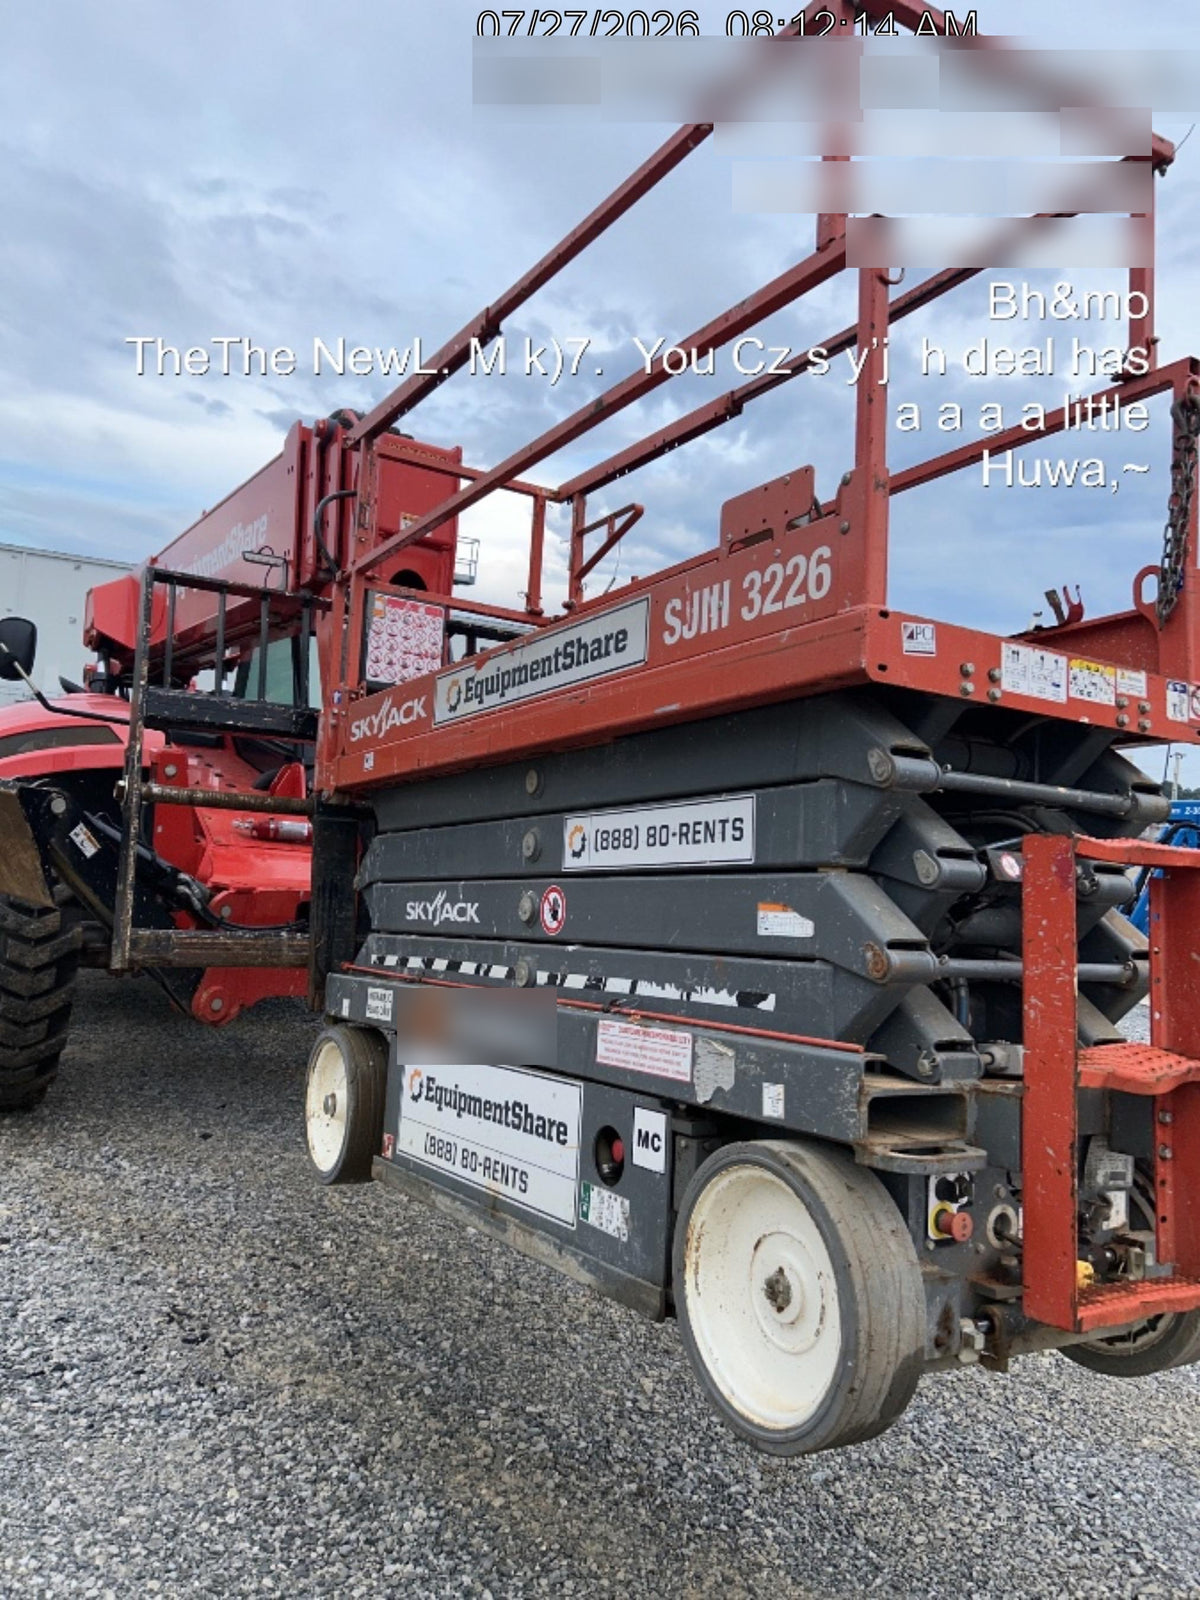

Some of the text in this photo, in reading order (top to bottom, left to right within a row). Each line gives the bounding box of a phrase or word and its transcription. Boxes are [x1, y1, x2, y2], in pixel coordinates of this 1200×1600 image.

[740, 545, 832, 622] 3226
[463, 628, 629, 706] EquipmentShare
[350, 694, 427, 743] SKYJACK
[594, 817, 744, 852] (888) 80-RENTS
[405, 889, 481, 927] SKYJACK
[424, 1076, 569, 1146] EquipmentShare
[424, 1132, 457, 1165] (888)
[461, 1148, 529, 1195] 80-RENTS
[637, 1128, 662, 1153] MC
